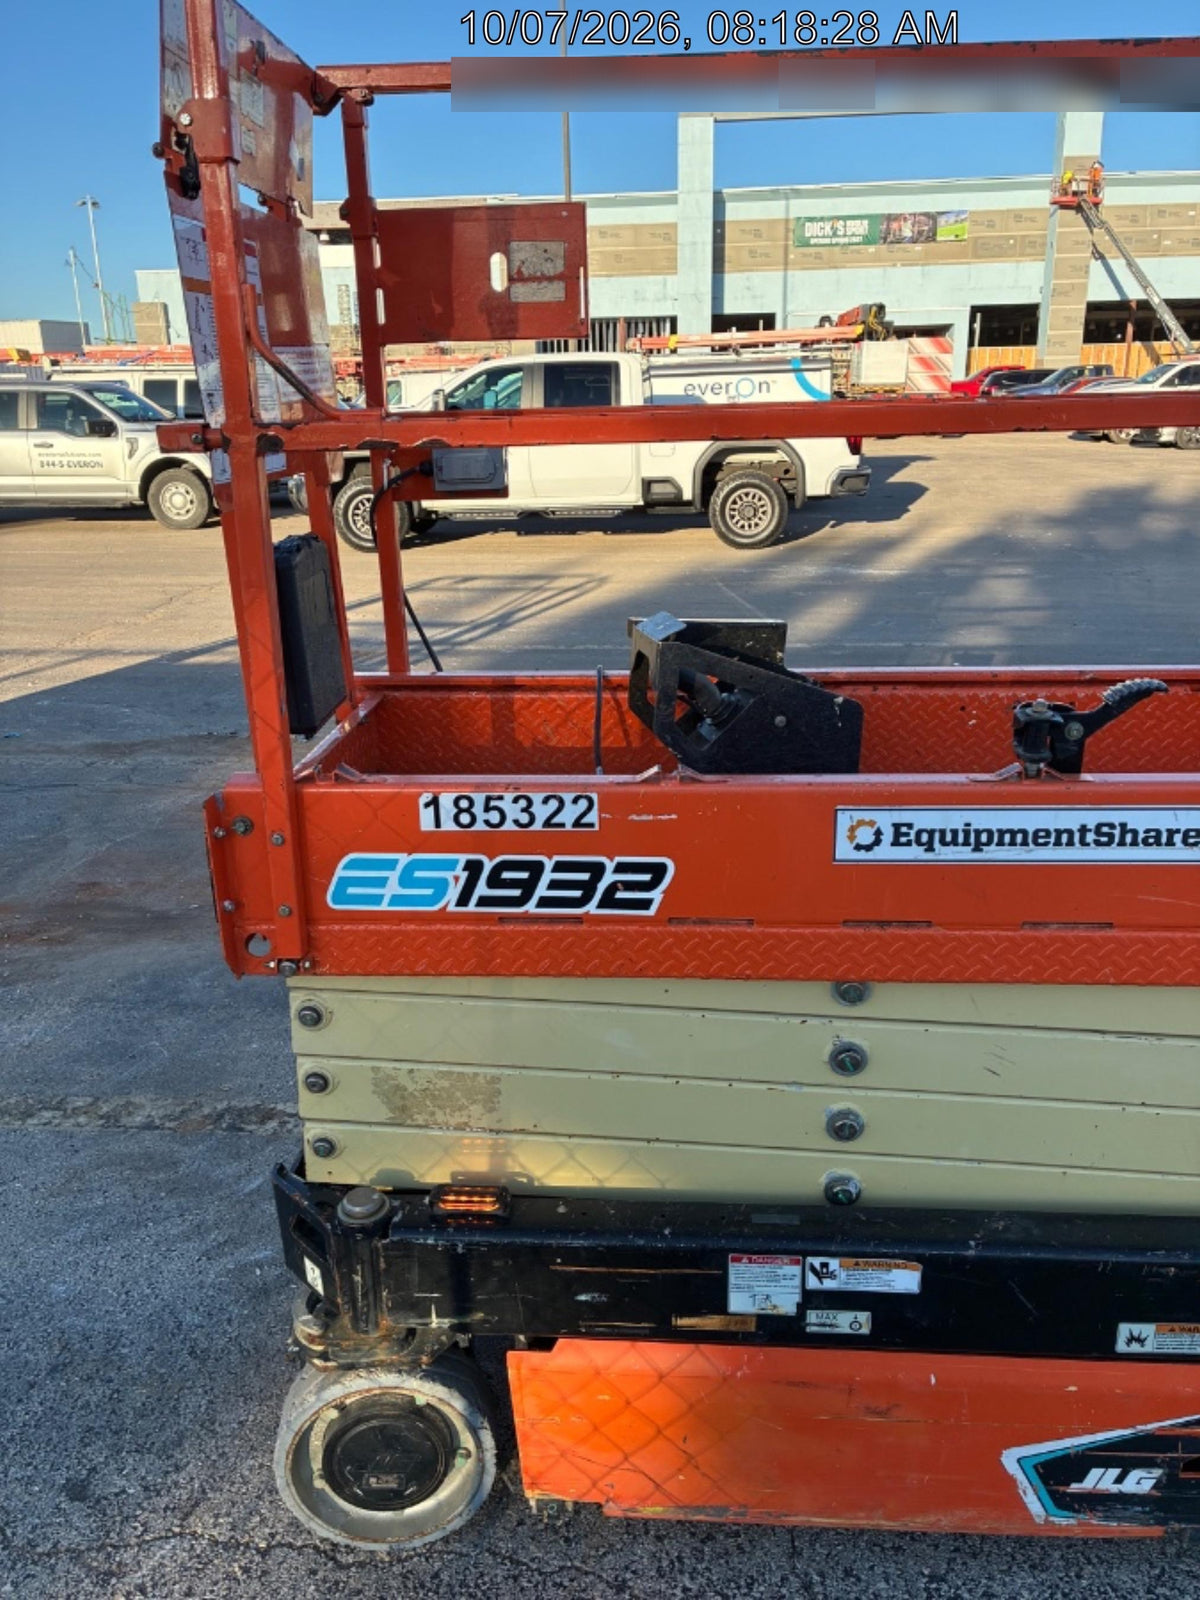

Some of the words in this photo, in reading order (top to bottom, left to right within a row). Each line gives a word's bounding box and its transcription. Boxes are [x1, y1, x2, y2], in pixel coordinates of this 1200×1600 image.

[805, 220, 845, 237] DICK'S
[423, 794, 596, 829] 185322
[890, 822, 1200, 852] EquipmentShare
[330, 857, 669, 911] ES1932
[862, 1260, 908, 1269] WARNING
[815, 1313, 839, 1321] MAX
[1066, 1467, 1164, 1494] JLG
